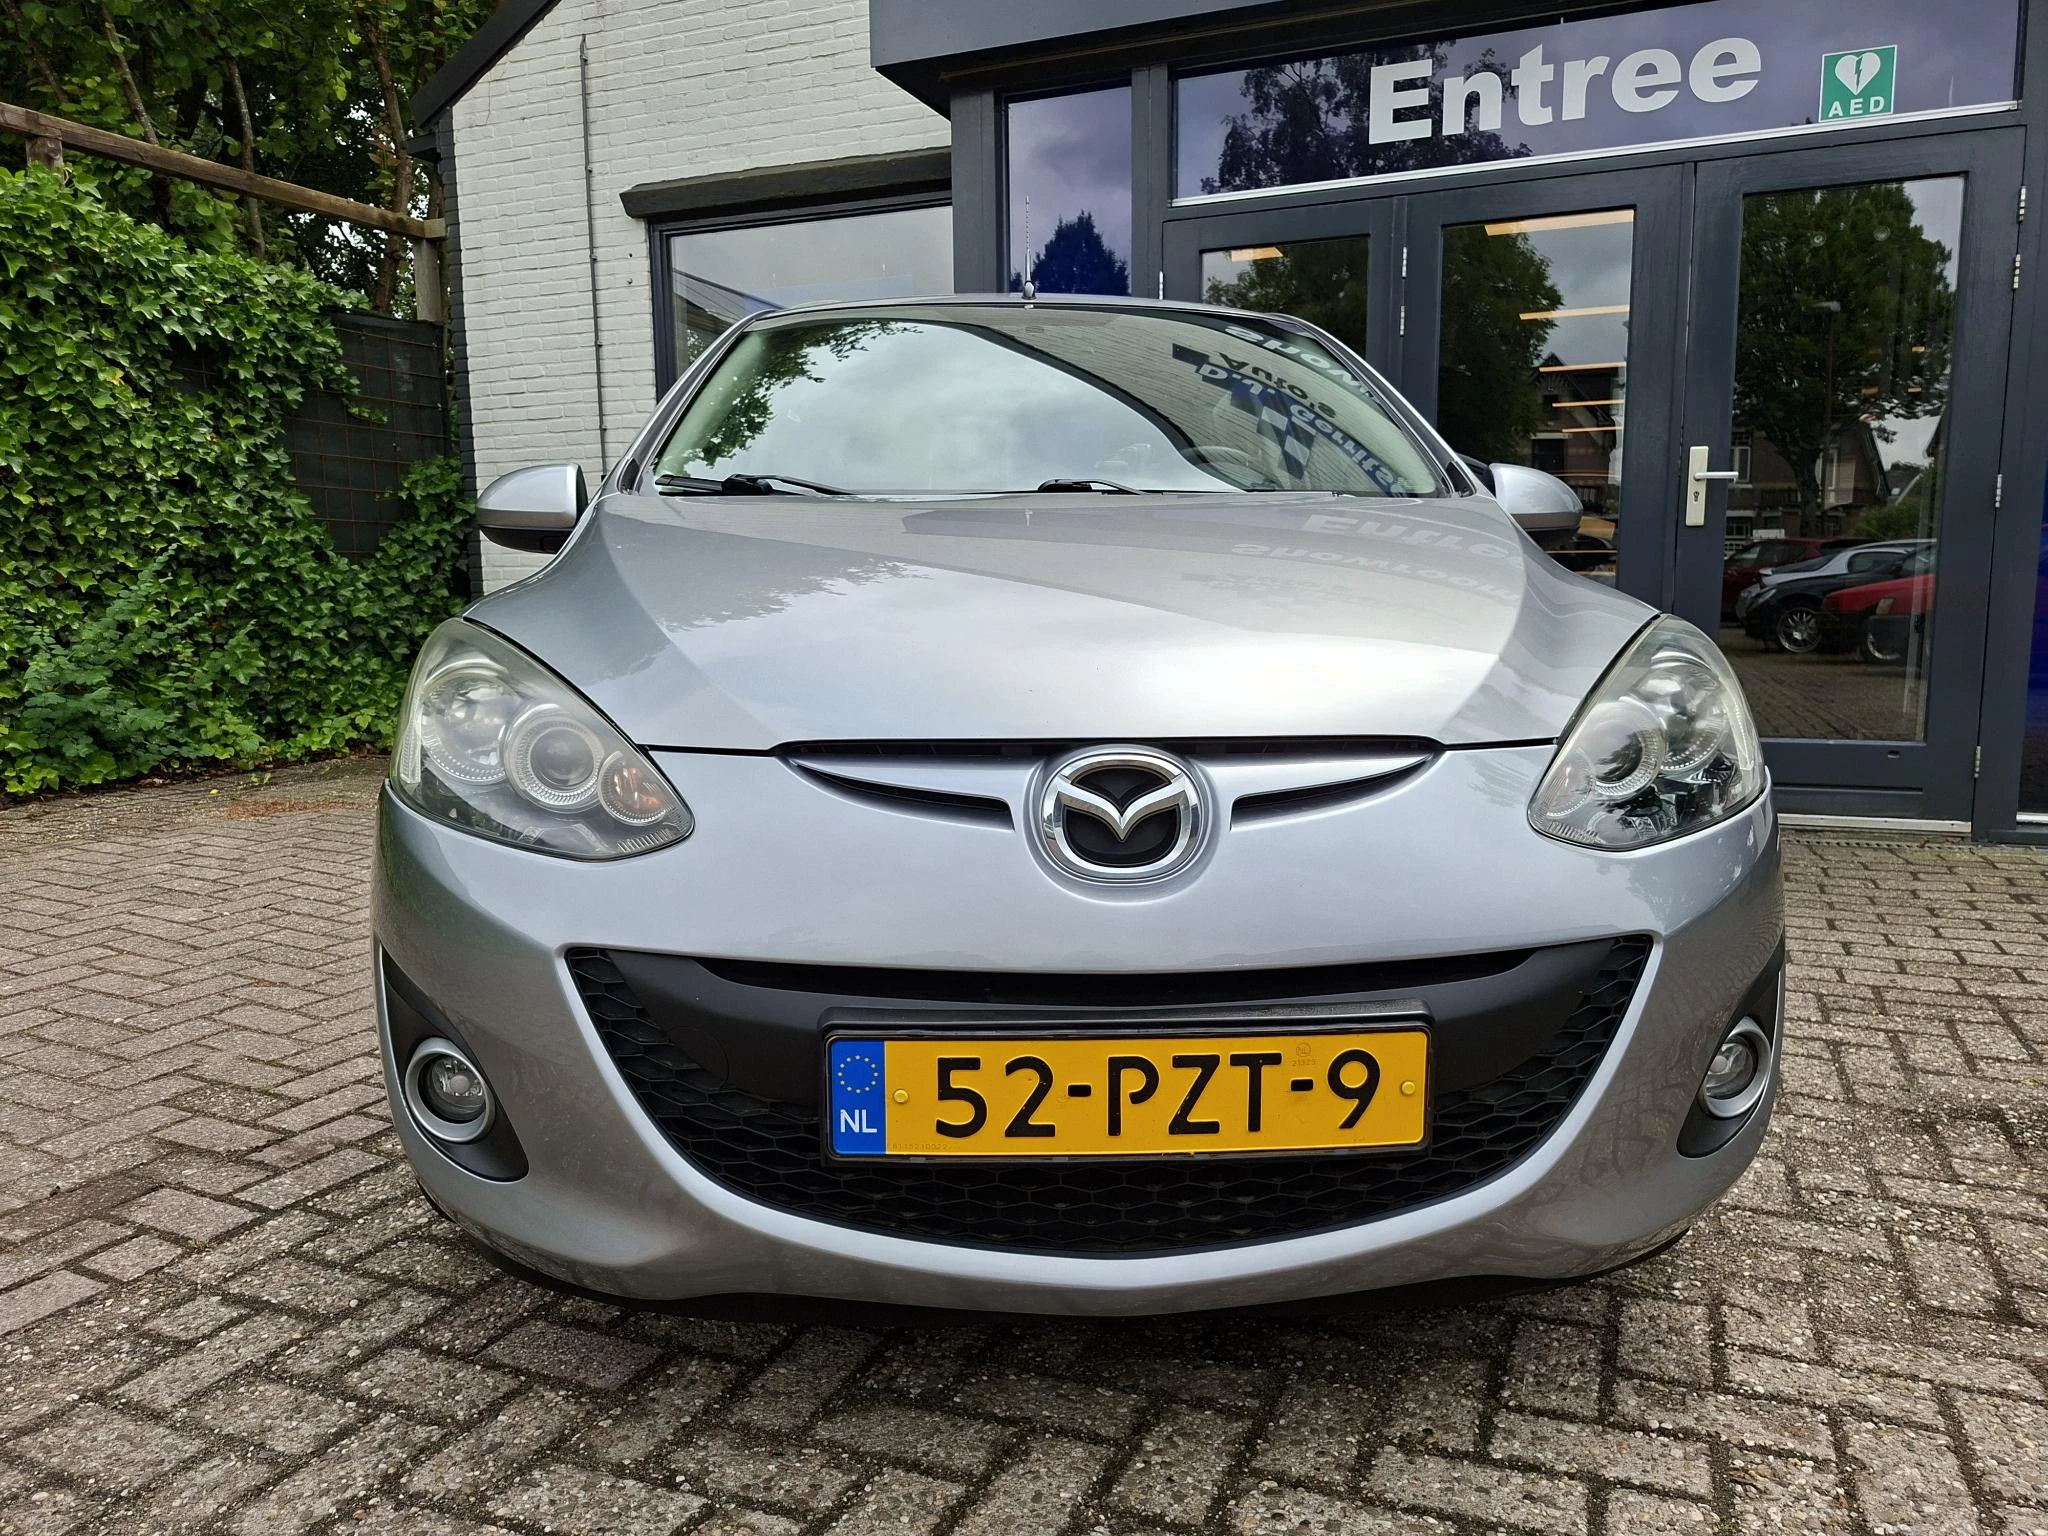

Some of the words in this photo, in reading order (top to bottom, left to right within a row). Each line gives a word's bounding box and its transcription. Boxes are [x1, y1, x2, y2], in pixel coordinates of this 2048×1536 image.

[1369, 37, 1761, 144] Entree
[1827, 95, 1886, 117] AED
[840, 1108, 877, 1134] NL
[935, 1048, 1381, 1138] 52-PZT-9
